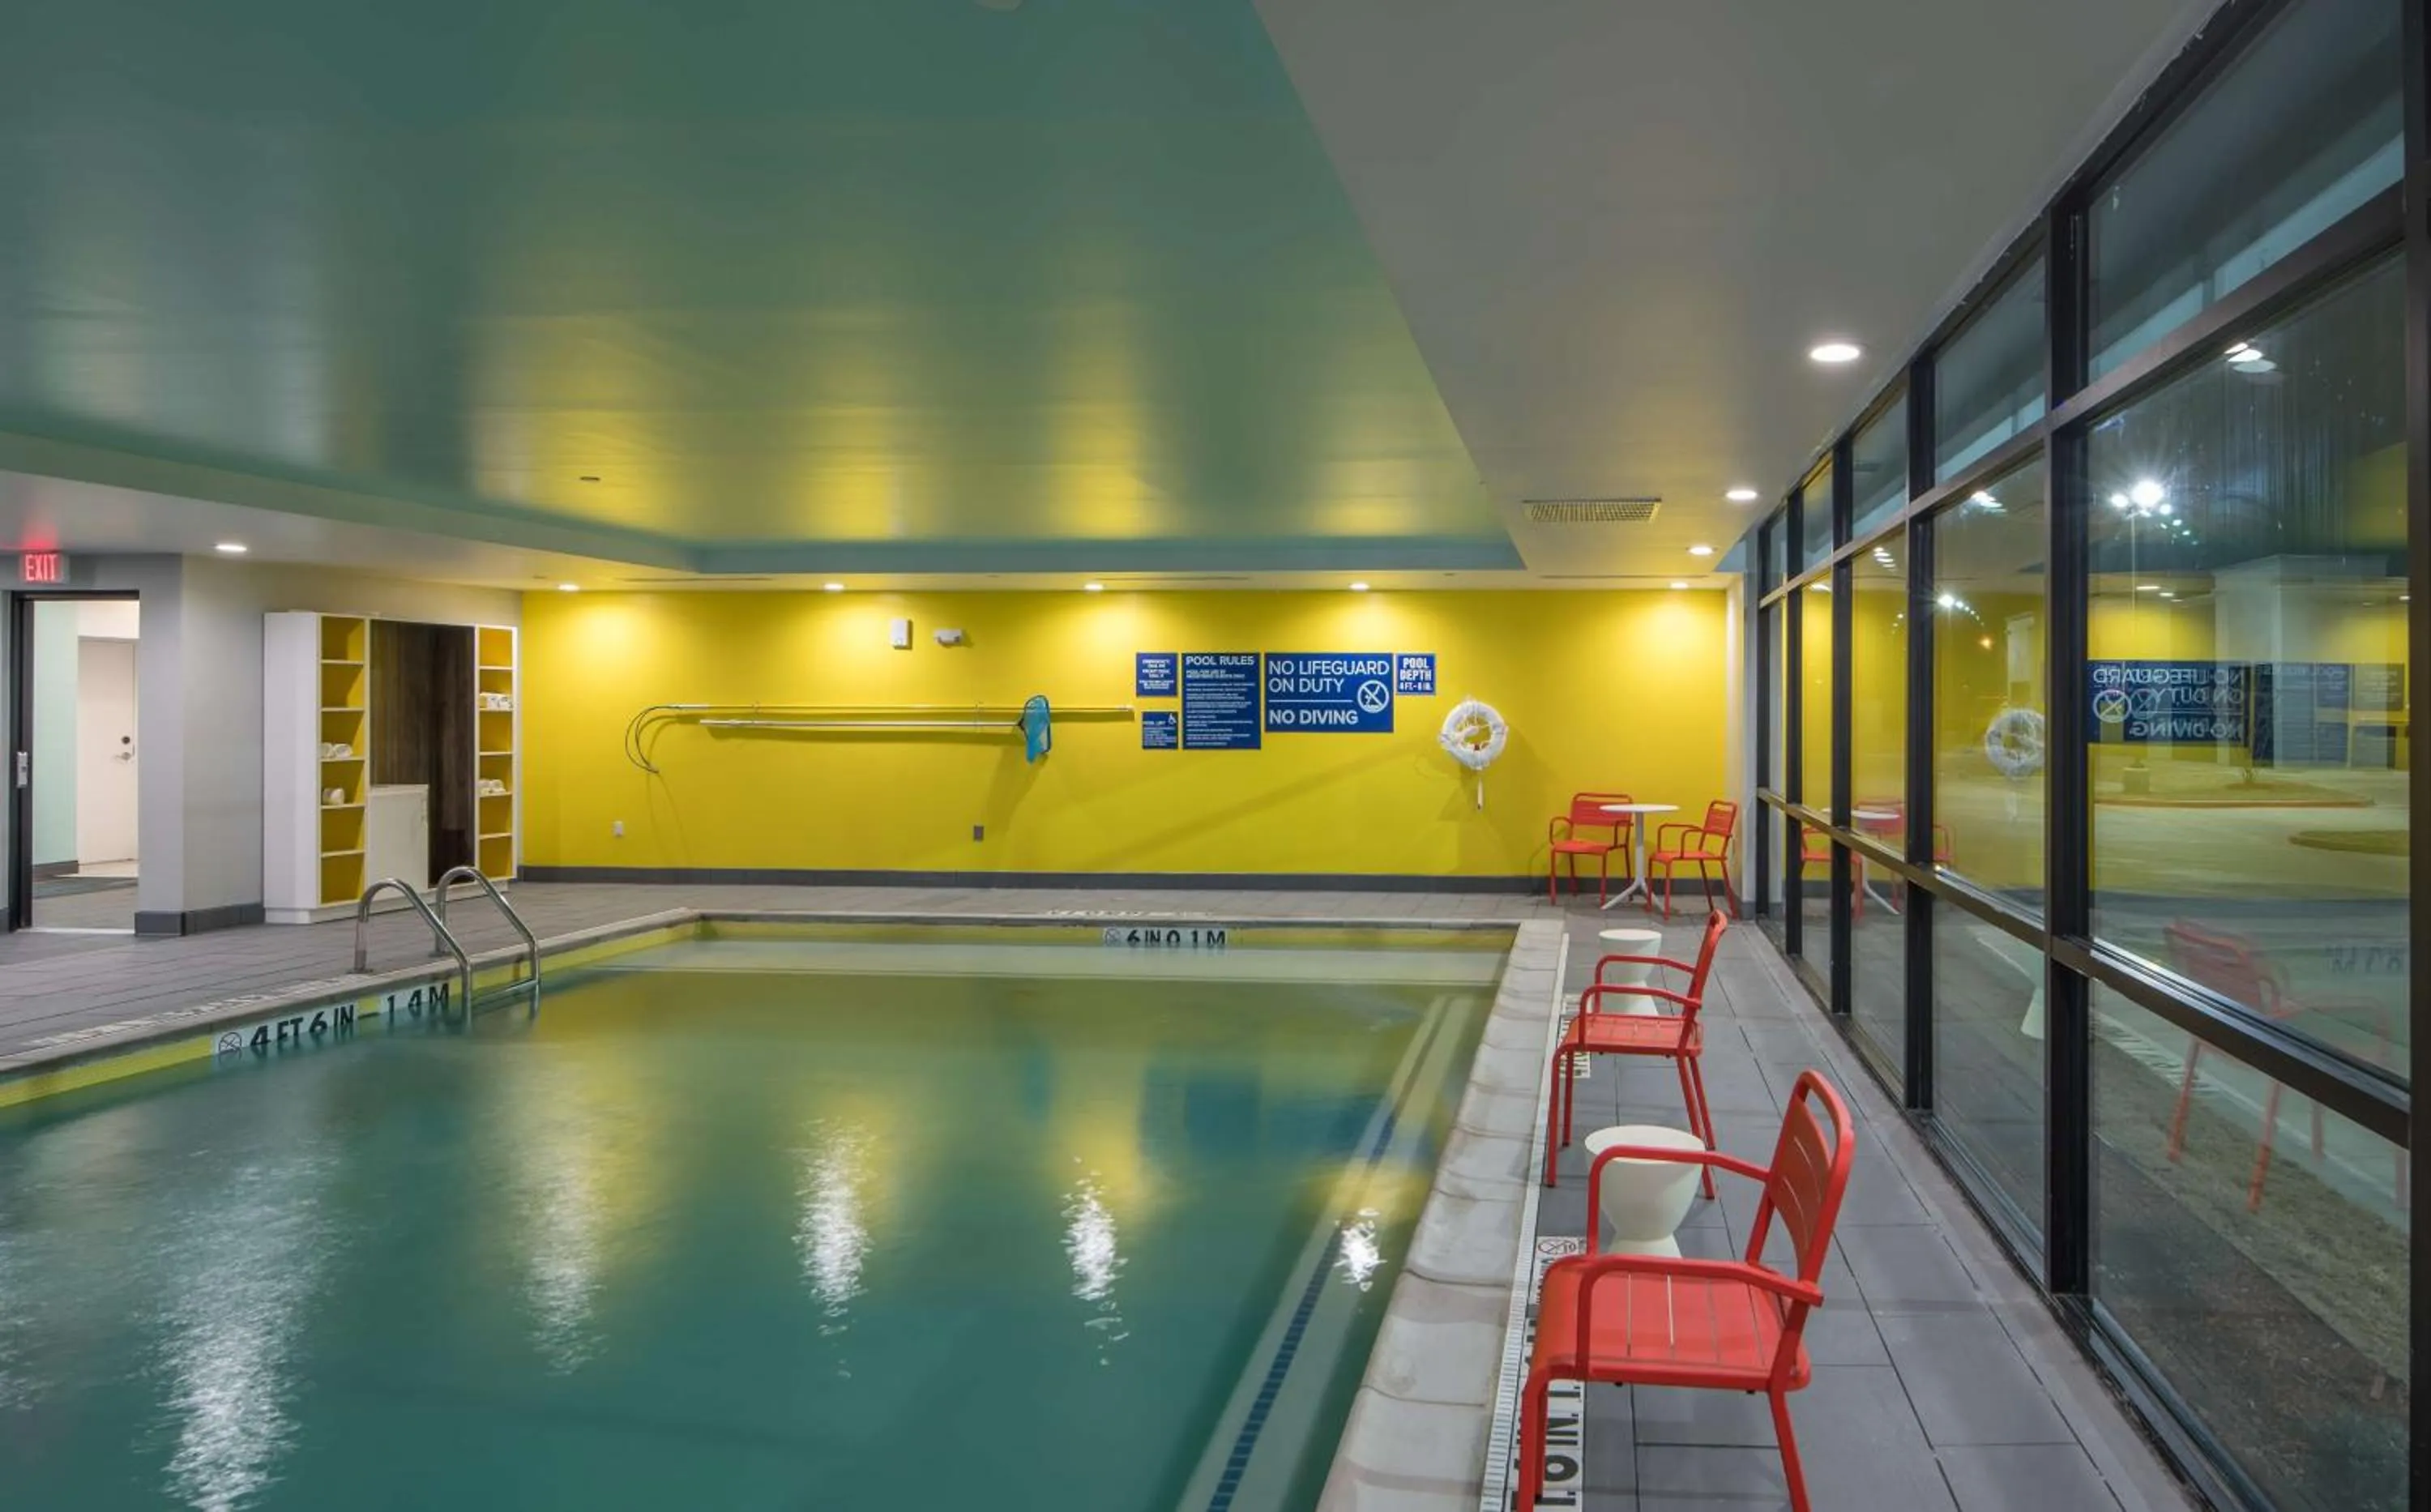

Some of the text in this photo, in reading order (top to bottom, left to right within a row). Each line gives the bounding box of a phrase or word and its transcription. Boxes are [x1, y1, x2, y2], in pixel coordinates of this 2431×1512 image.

[25, 553, 58, 581] EXIT
[1186, 656, 1255, 665] POOL RULES
[1268, 660, 1390, 675] NO LIFEGUARD
[1403, 657, 1429, 668] POOL
[1399, 669, 1433, 681] DEPTH
[1268, 677, 1345, 693] ON DUTY
[1268, 709, 1359, 725] NO DIVING
